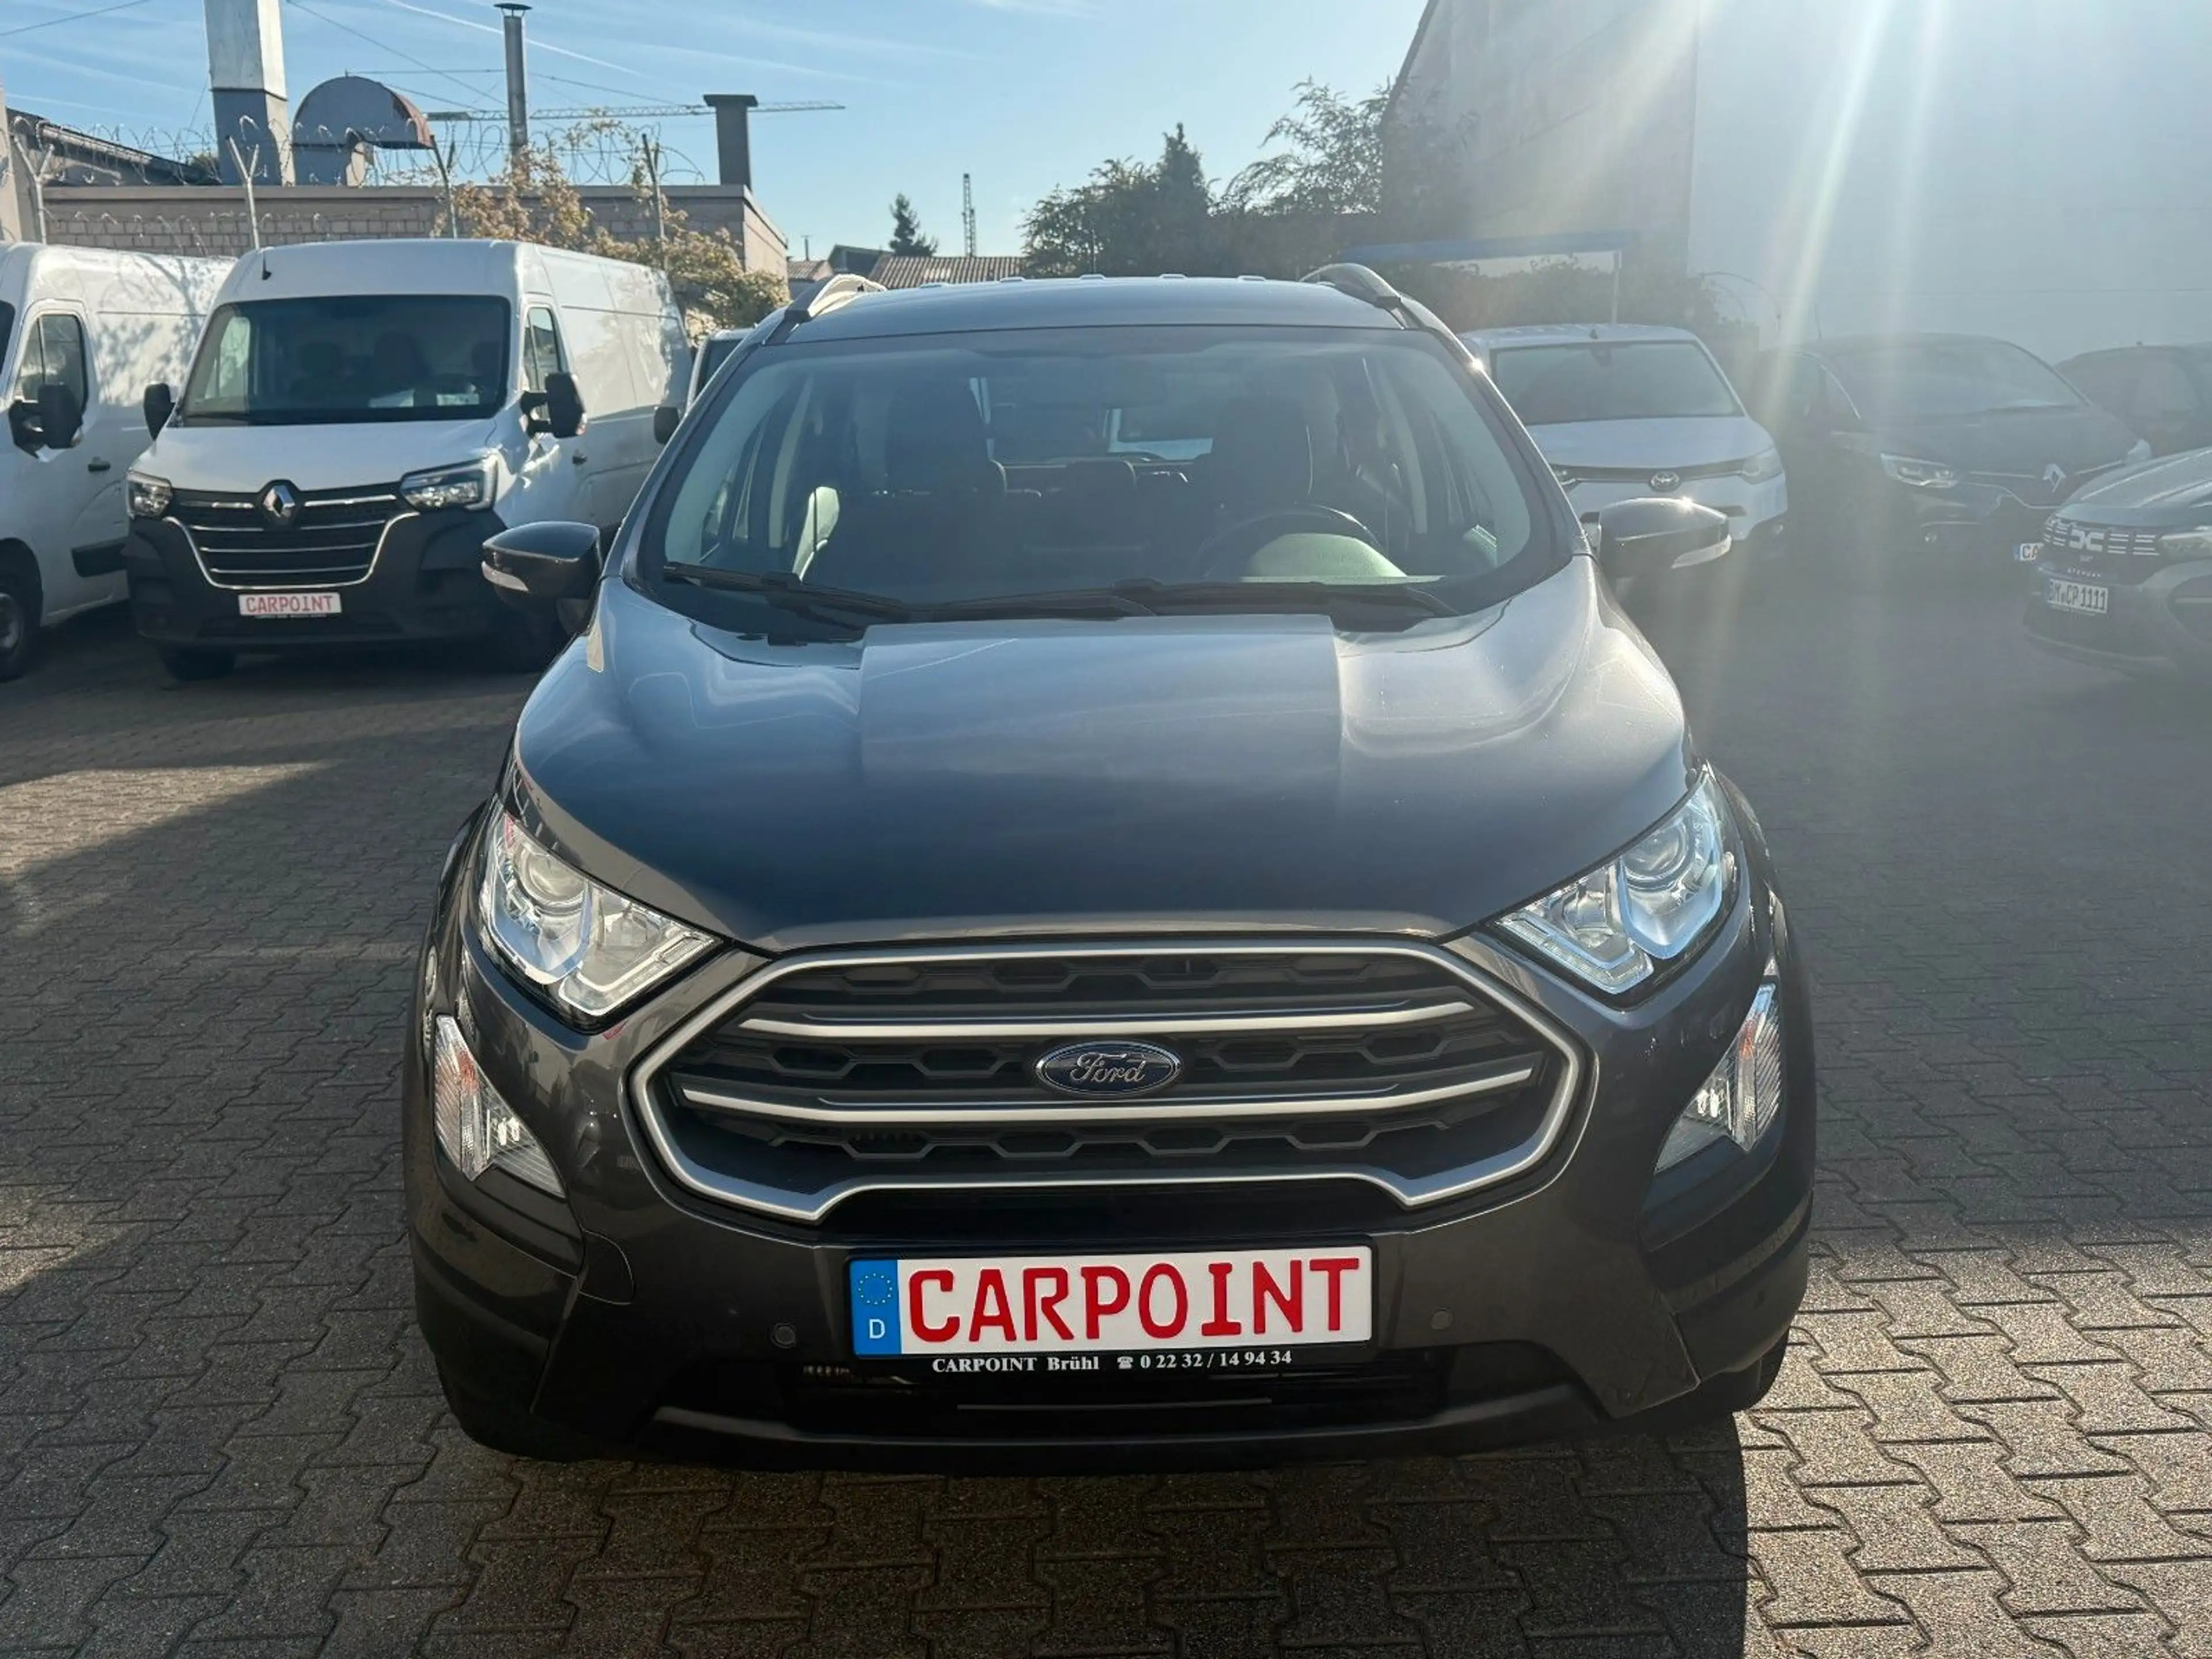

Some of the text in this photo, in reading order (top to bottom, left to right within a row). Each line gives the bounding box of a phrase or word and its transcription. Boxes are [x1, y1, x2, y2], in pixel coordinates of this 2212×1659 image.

[246, 596, 334, 613] CARPOINT
[1070, 1052, 1146, 1082] Ford
[909, 1258, 1359, 1342] CARPOINT
[869, 1319, 885, 1339] D
[932, 1357, 1037, 1372] CARPOINT
[1047, 1356, 1100, 1370] Brühl
[1140, 1355, 1151, 1369] 0
[1156, 1354, 1177, 1368] 22
[1181, 1354, 1203, 1368] 32
[1219, 1352, 1240, 1367] 14
[1244, 1351, 1266, 1366] 94
[1270, 1350, 1292, 1365] 34
